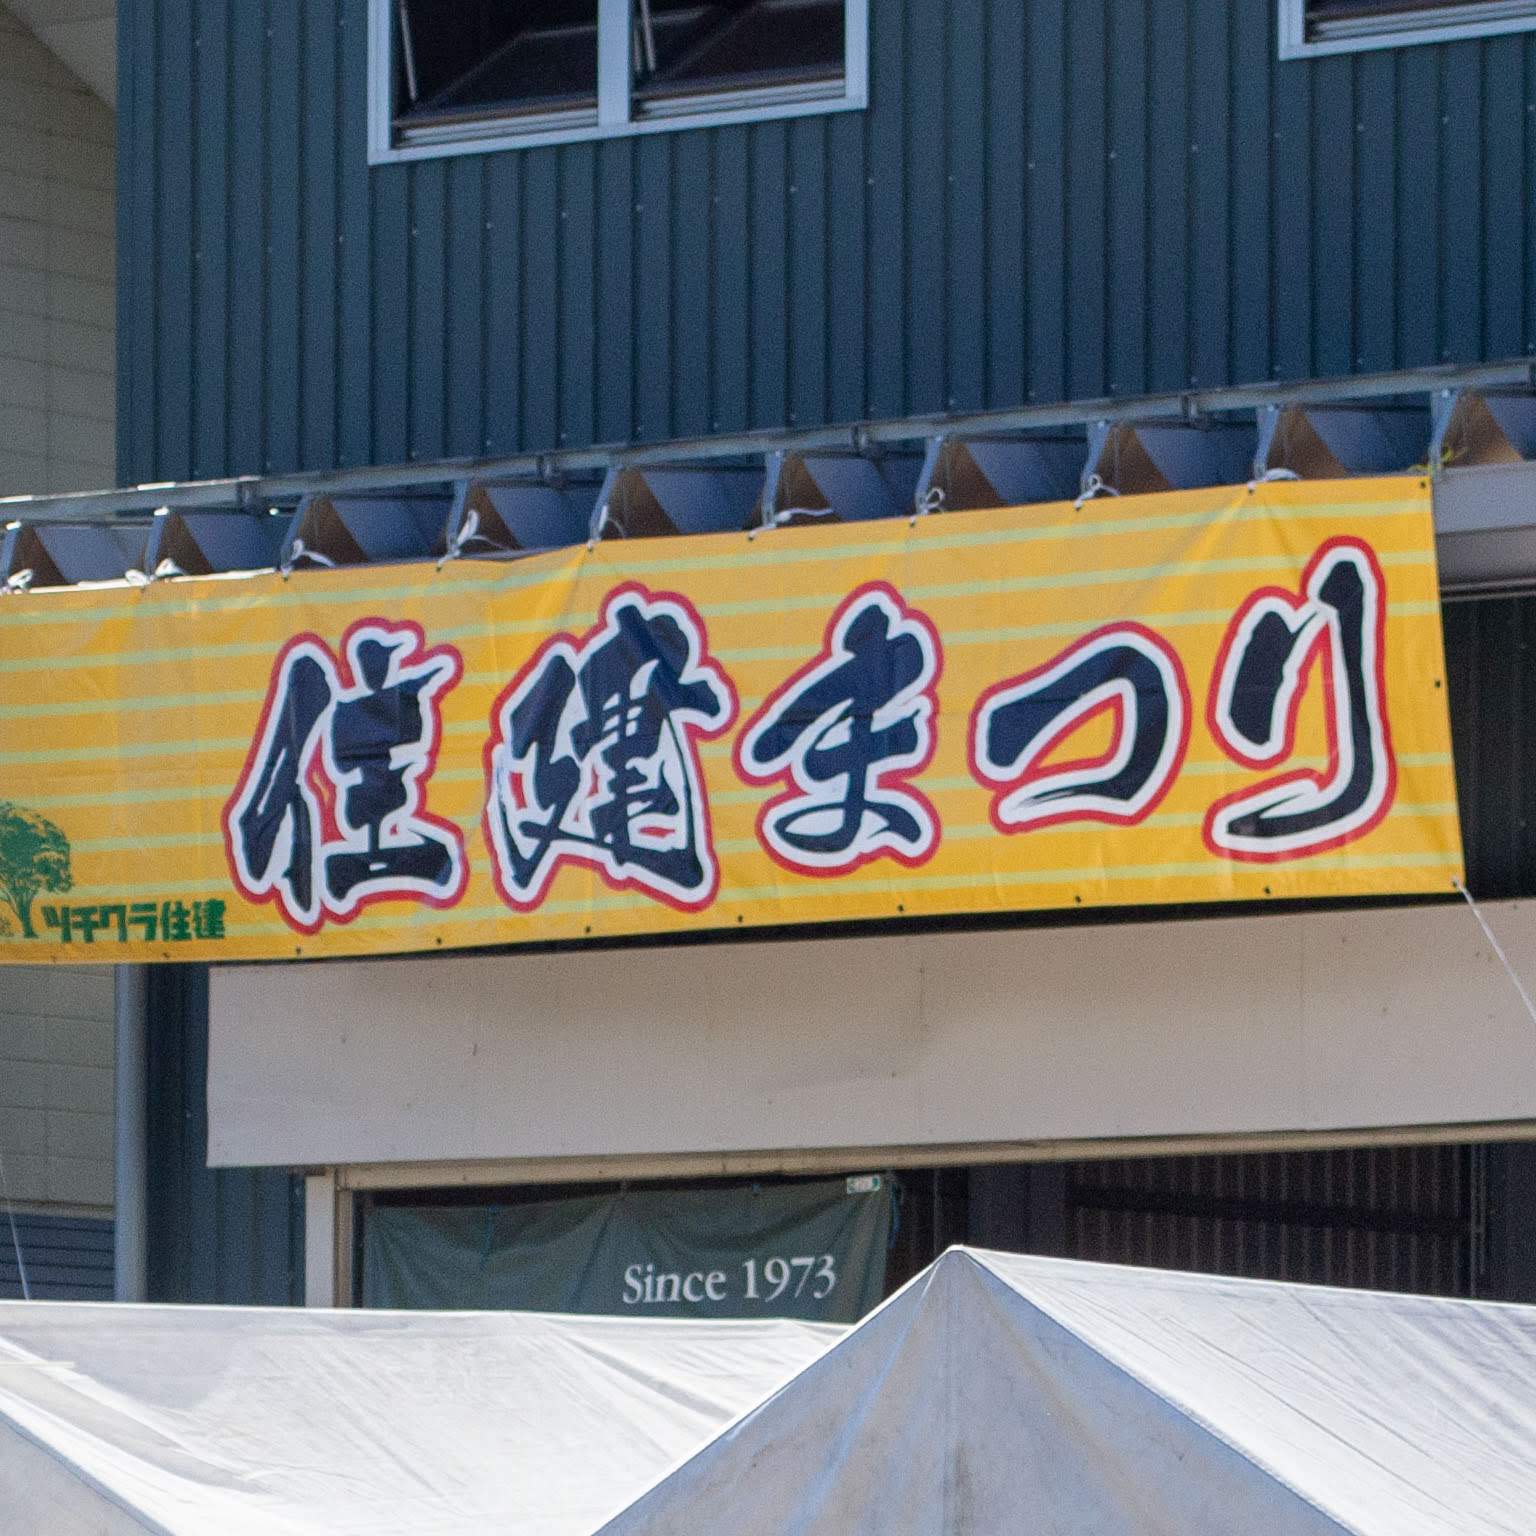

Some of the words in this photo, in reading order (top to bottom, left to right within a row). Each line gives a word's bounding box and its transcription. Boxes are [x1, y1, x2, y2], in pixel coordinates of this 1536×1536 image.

[224, 537, 1398, 934] 住建まつり
[41, 899, 226, 943] ツチクラ住建
[622, 1263, 727, 1304] Since
[742, 1254, 837, 1302] 1973
